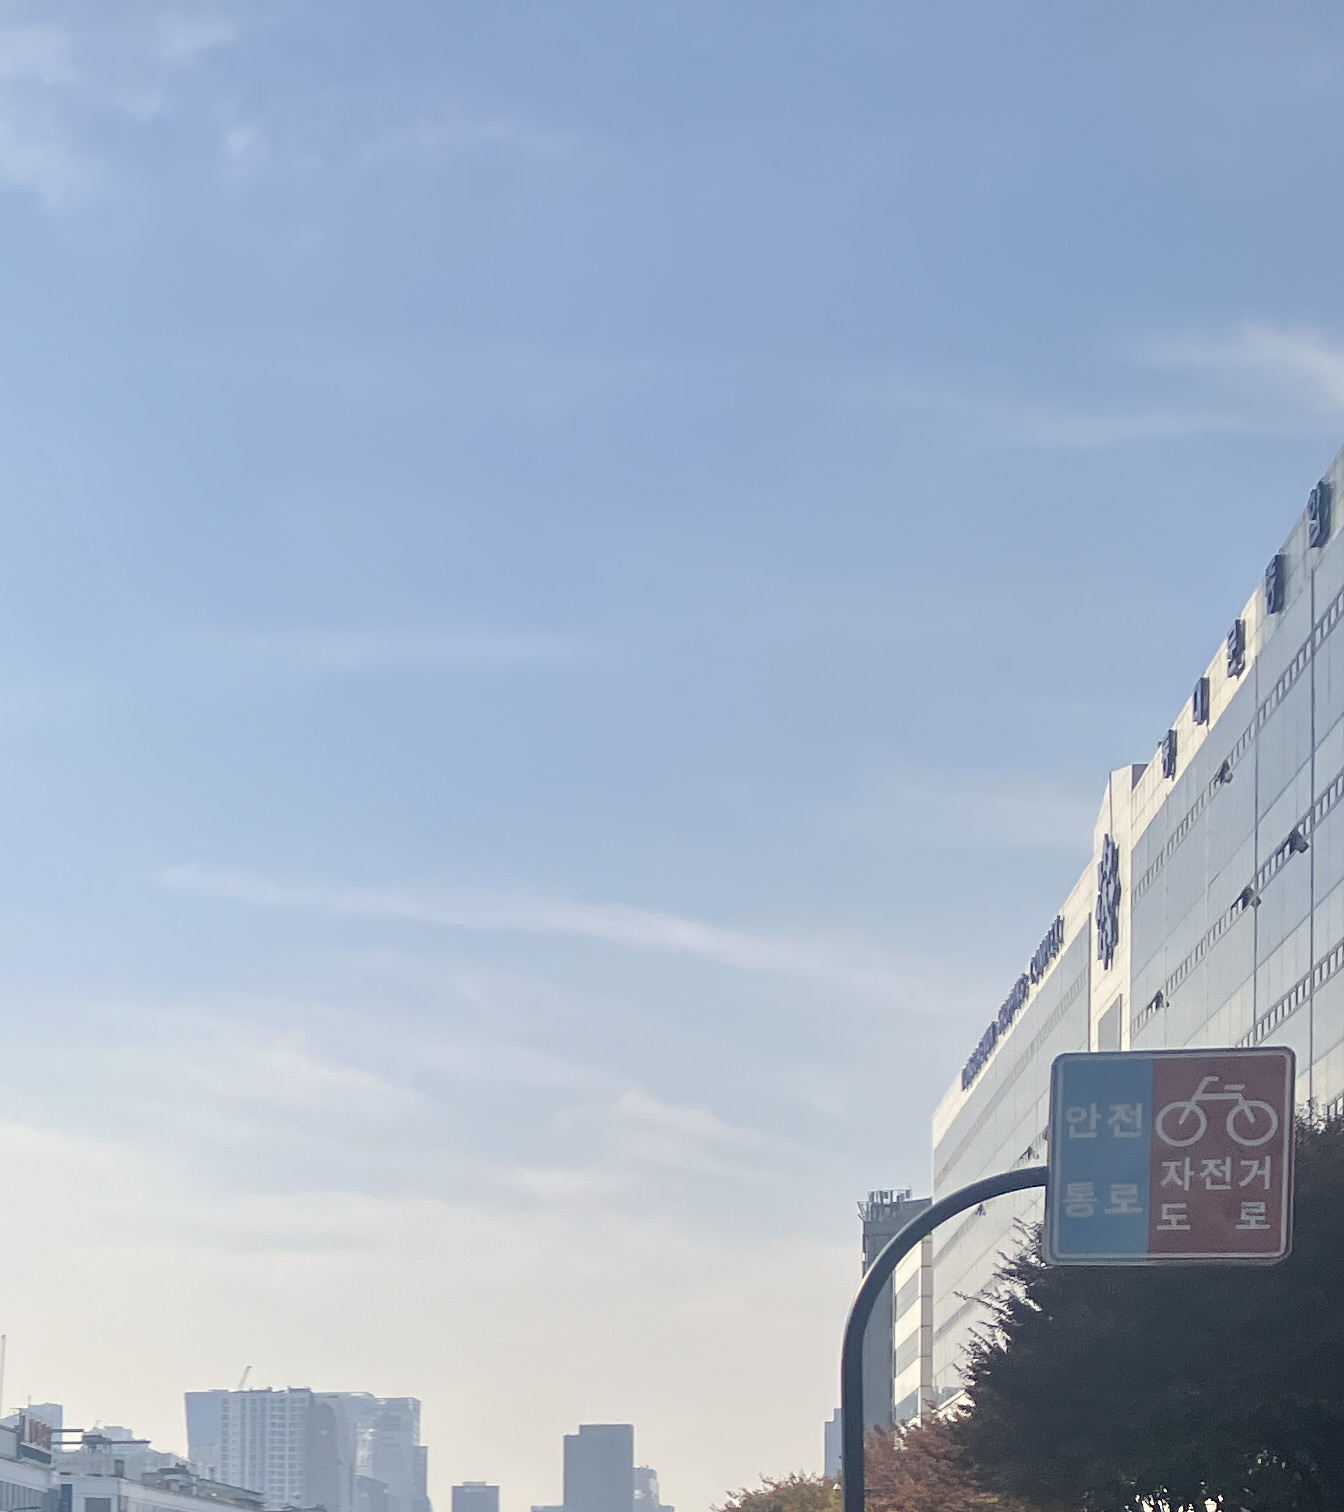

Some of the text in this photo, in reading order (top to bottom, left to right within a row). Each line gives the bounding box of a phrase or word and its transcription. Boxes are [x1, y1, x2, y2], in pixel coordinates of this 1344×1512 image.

[1065, 1101, 1143, 1140] 안전
[1161, 1156, 1272, 1192] 자전거
[1065, 1181, 1144, 1218] 통로
[1157, 1202, 1271, 1231] 도로
